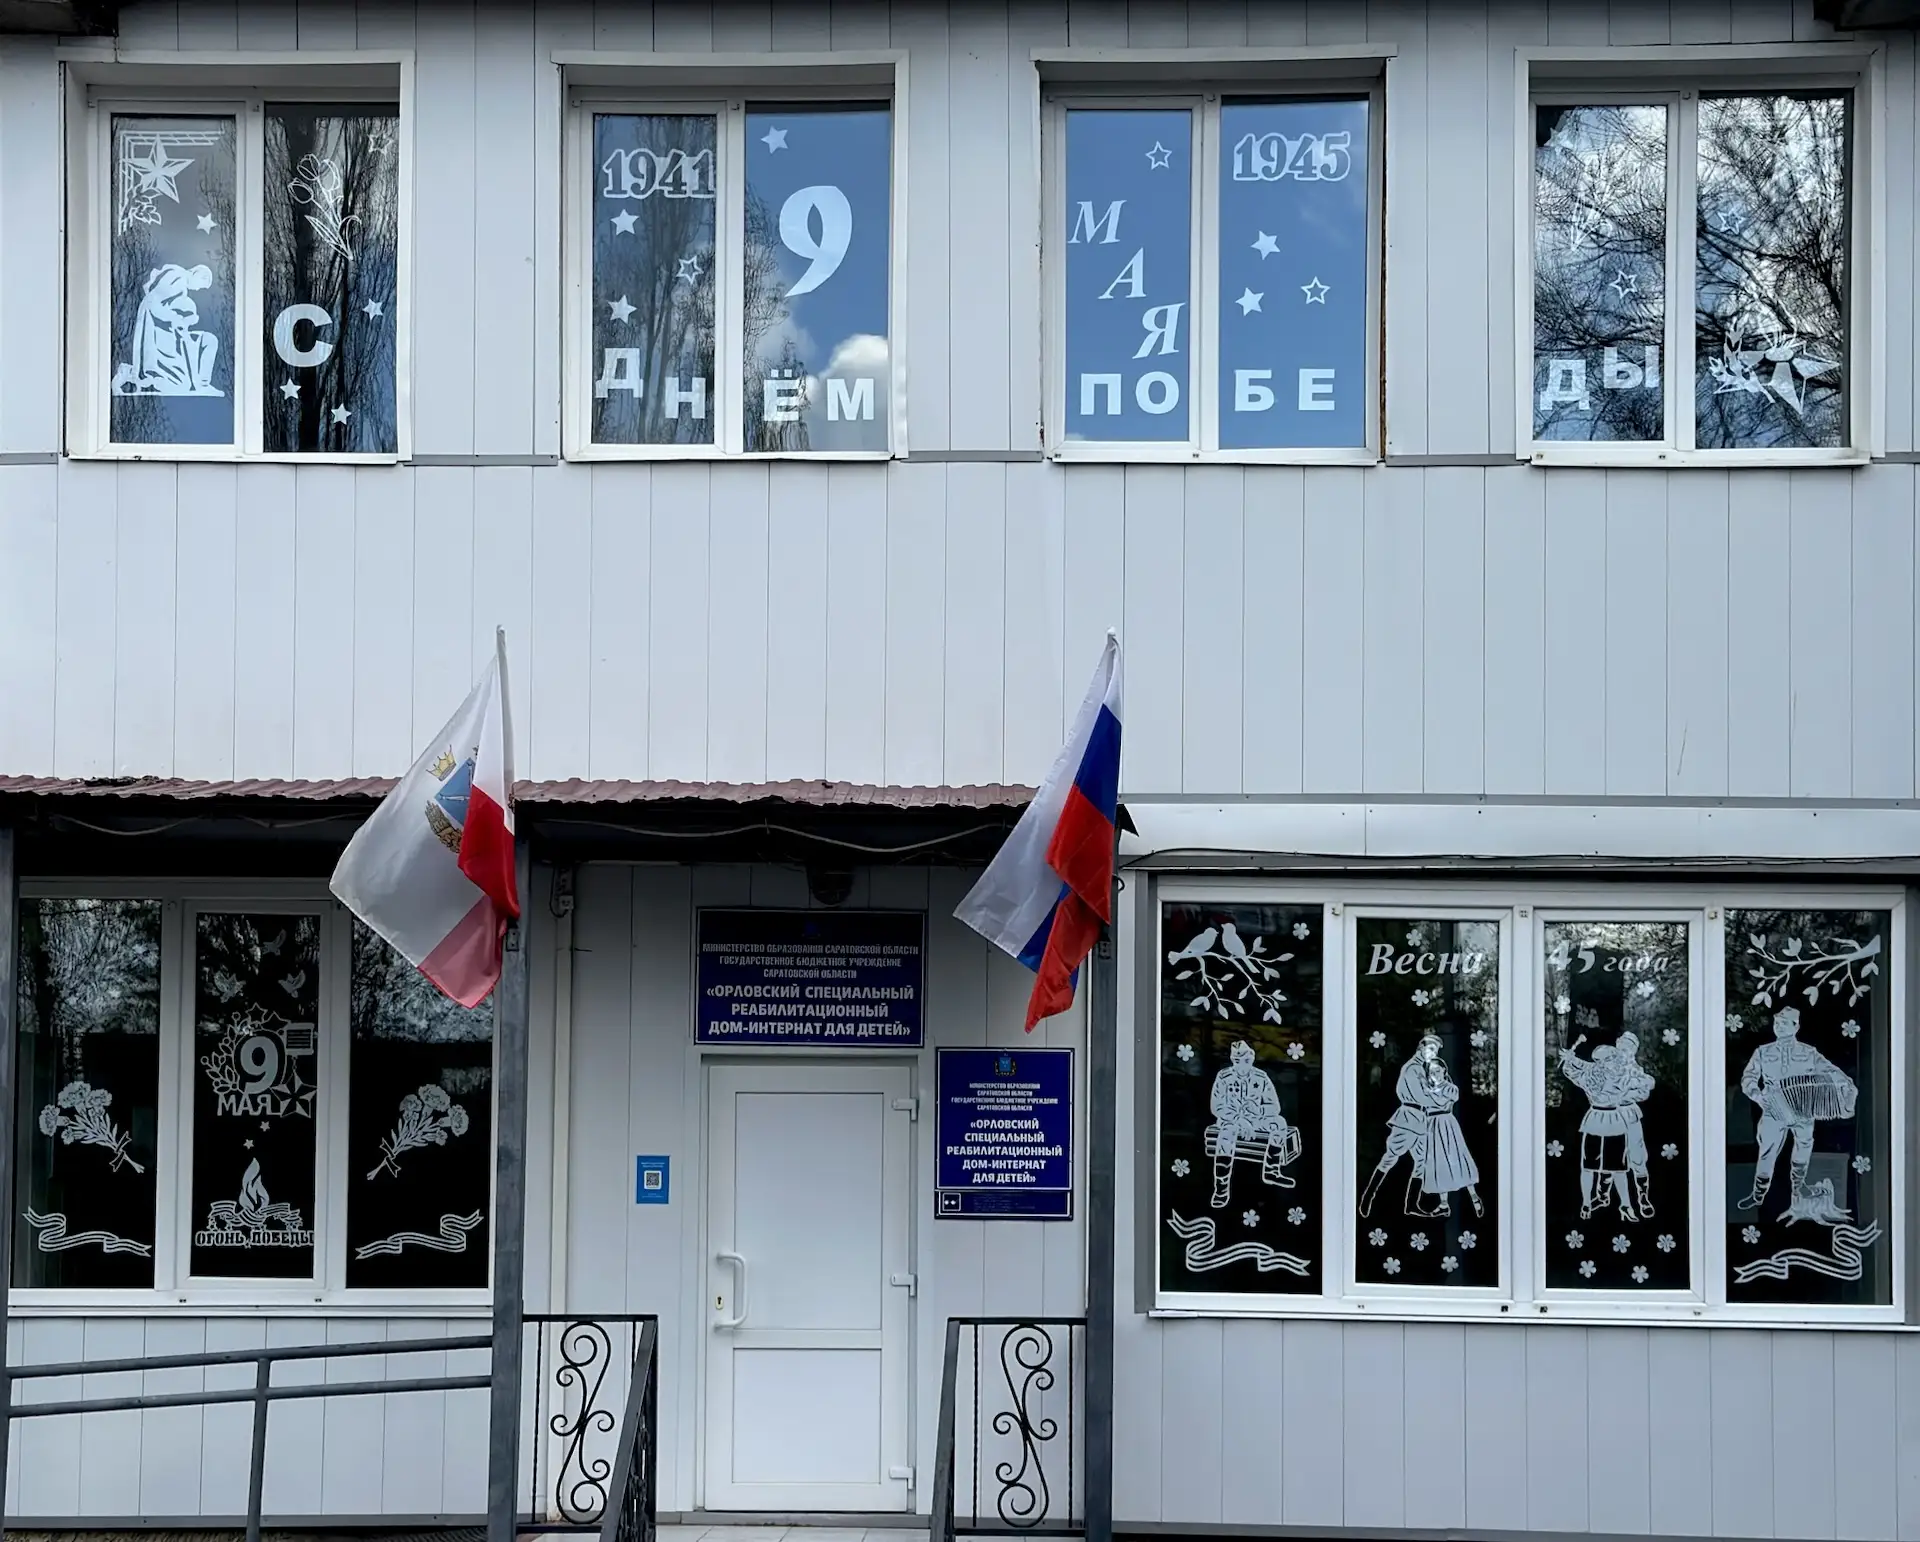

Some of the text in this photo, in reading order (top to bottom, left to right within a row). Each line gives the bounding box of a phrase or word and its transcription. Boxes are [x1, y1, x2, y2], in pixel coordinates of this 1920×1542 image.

[1233, 130, 1352, 182] 1945
[603, 148, 717, 199] 1941
[779, 185, 853, 298] 9
[273, 303, 334, 367] С
[702, 943, 919, 956] МИНИСТЕРСТВО ОБРАЗОВАНИЯ САРАТОВСКОЙ ОБЛАСТИ
[1365, 939, 1670, 975] Весна 45 года
[719, 955, 902, 968] ГОСУДАРСТВЕННОЕ БЮДЖЕТНОЕ УЧРЕЖДЕНИЕ
[763, 967, 857, 979] САРАТОВСКОЙ ОБЛАСТИ
[707, 983, 914, 1000] «ОРЛОВСКИЙ СПЕЦИАЛЬНЫЙ
[731, 1002, 889, 1019] РЕАБИЛИТАЦИОННЫЙ
[708, 1020, 911, 1037] ДОМ-ИНТЕРНАТ ДЛЯ ДЕТЕЙ»
[240, 1035, 279, 1095] 9
[217, 1093, 272, 1117] МАЯ
[970, 1118, 1040, 1129] «ОРЛОВСКИЙ
[964, 1131, 1045, 1144] СПЕЦИАЛЬНЫЙ
[946, 1145, 1063, 1158] РЕАБИЛИТАЦИОННЫЙ
[962, 1159, 1047, 1171] ДОМ-ИНТЕРНАТ
[972, 1171, 1037, 1184] ДЛЯ ДЕТЕЙ»
[195, 1230, 315, 1248] ОГОНЬ ПОБЕДЫ
